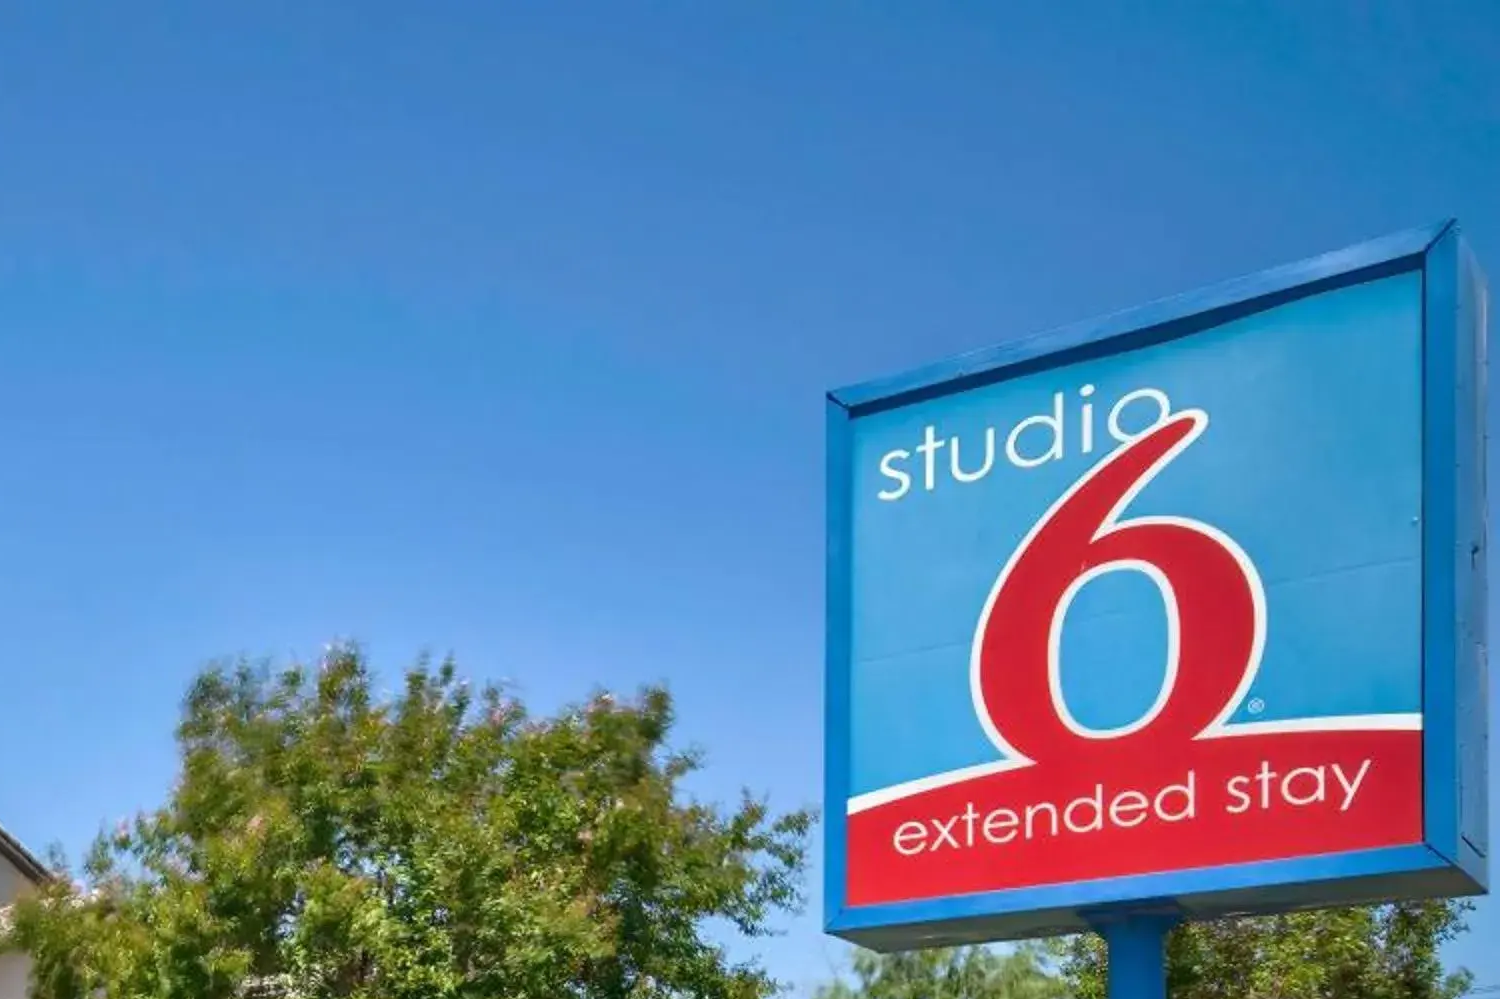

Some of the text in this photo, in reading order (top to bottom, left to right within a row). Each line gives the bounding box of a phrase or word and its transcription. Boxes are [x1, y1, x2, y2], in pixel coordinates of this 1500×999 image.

[877, 384, 1171, 502] studio
[970, 408, 1268, 766] 6
[893, 759, 1371, 857] extended stay
